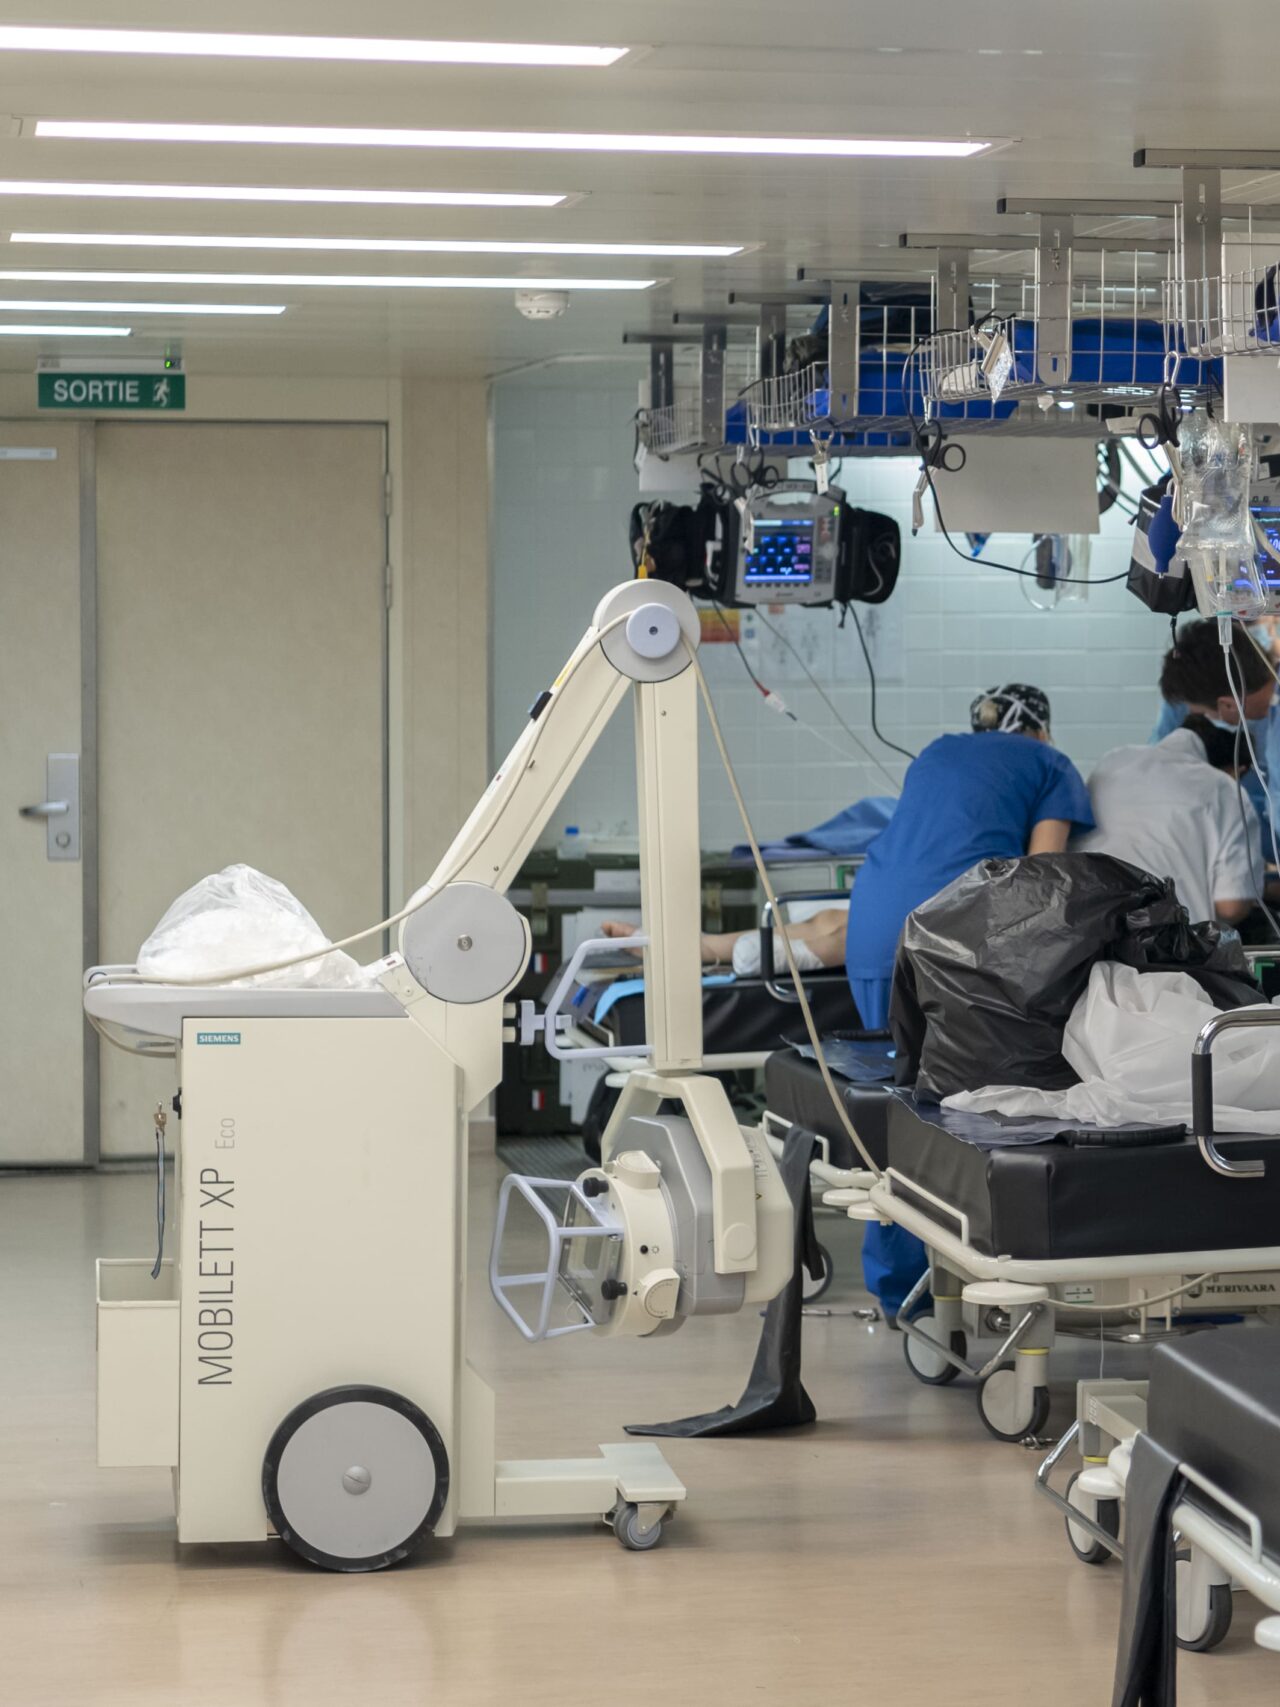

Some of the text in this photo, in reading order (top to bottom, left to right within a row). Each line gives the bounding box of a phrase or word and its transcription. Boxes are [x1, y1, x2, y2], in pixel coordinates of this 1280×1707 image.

[53, 378, 140, 403] SORTIE
[199, 1034, 240, 1043] SIEMENS
[197, 1117, 236, 1385] MOBILETT XP Eco
[1205, 1283, 1277, 1294] MERIVAARA
